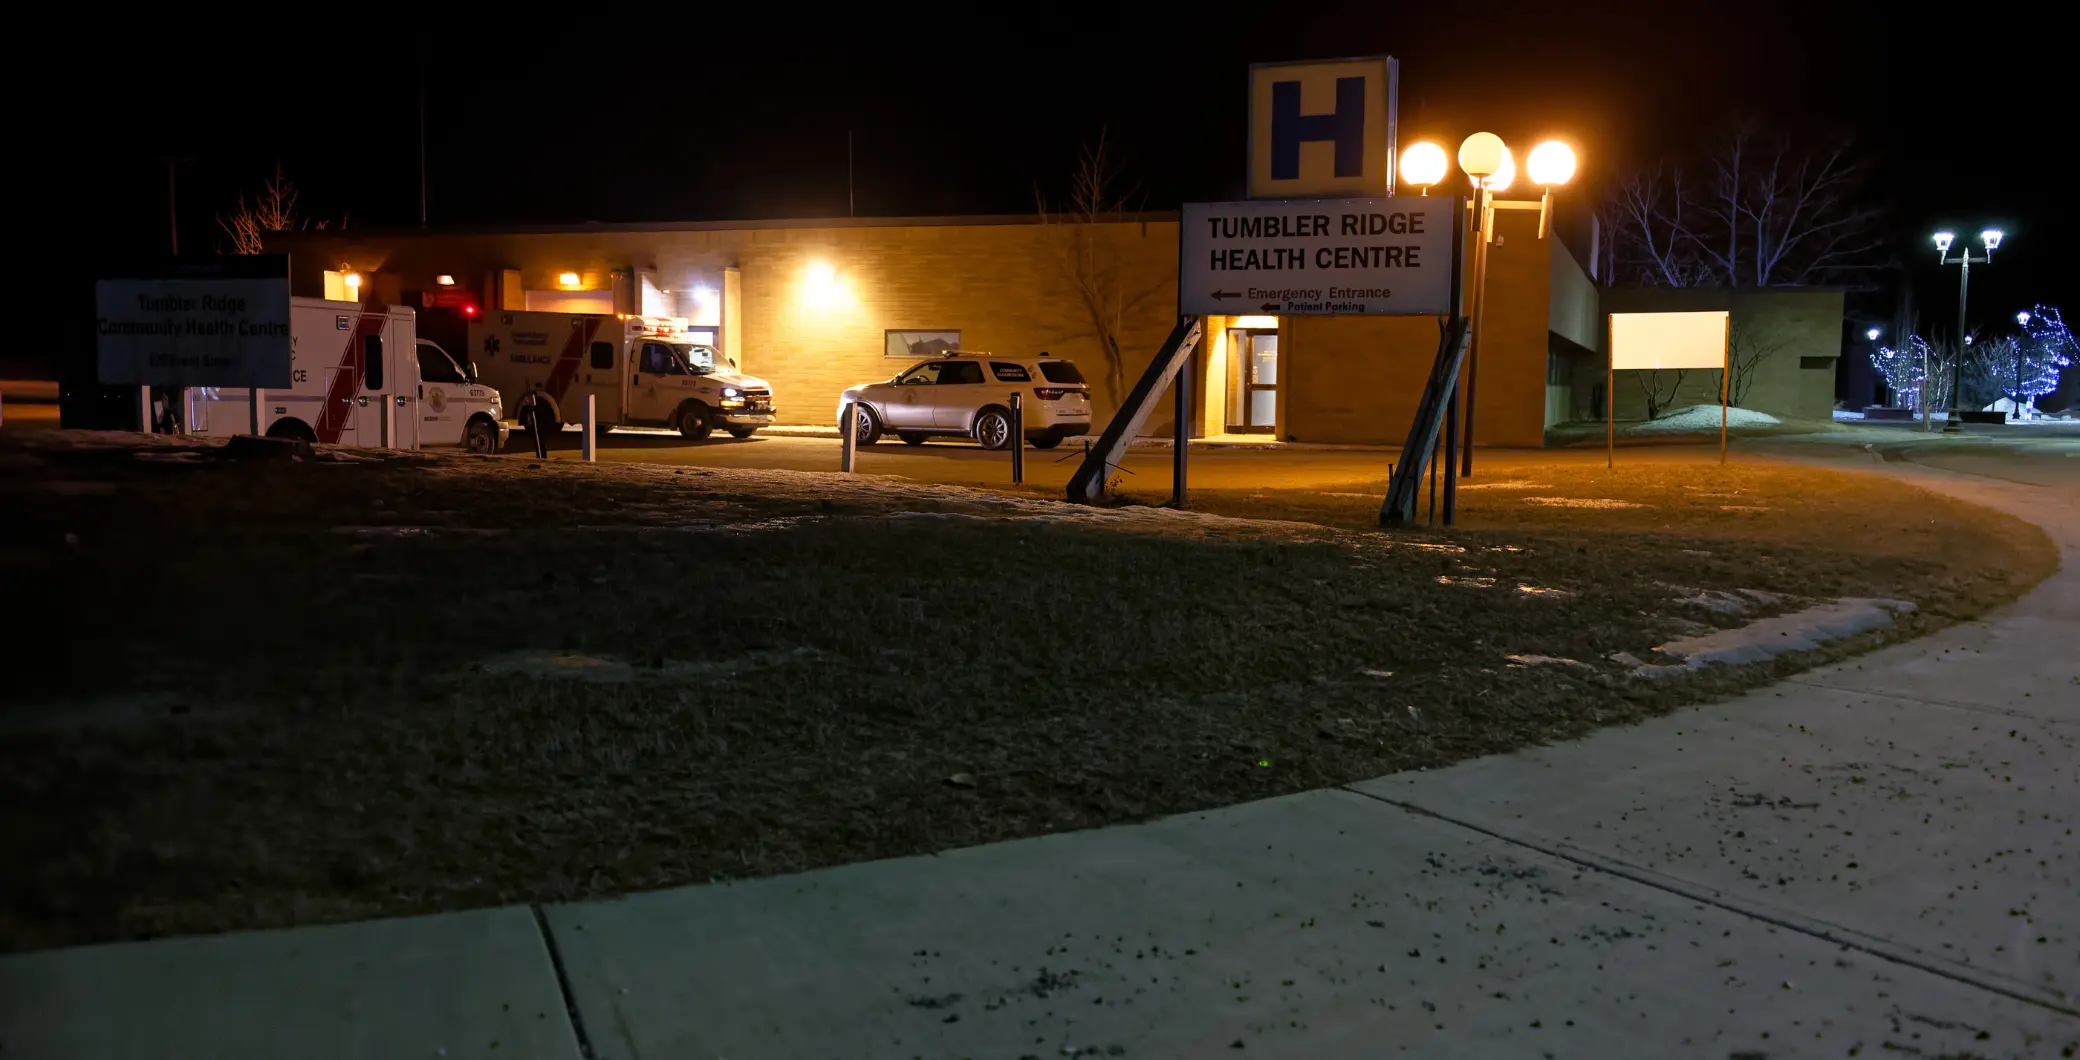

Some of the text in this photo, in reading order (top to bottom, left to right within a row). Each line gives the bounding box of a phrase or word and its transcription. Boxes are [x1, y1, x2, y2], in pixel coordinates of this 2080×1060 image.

[1271, 76, 1366, 181] H
[1208, 212, 1426, 239] TUMBLER RIDGE
[1210, 245, 1422, 272] HEALTH CENTRE
[138, 294, 246, 316] Tumbler Ridge
[1248, 286, 1391, 302] Emergency Entrance
[1288, 301, 1366, 313] Patient Parking
[97, 317, 289, 338] Community Health Centre
